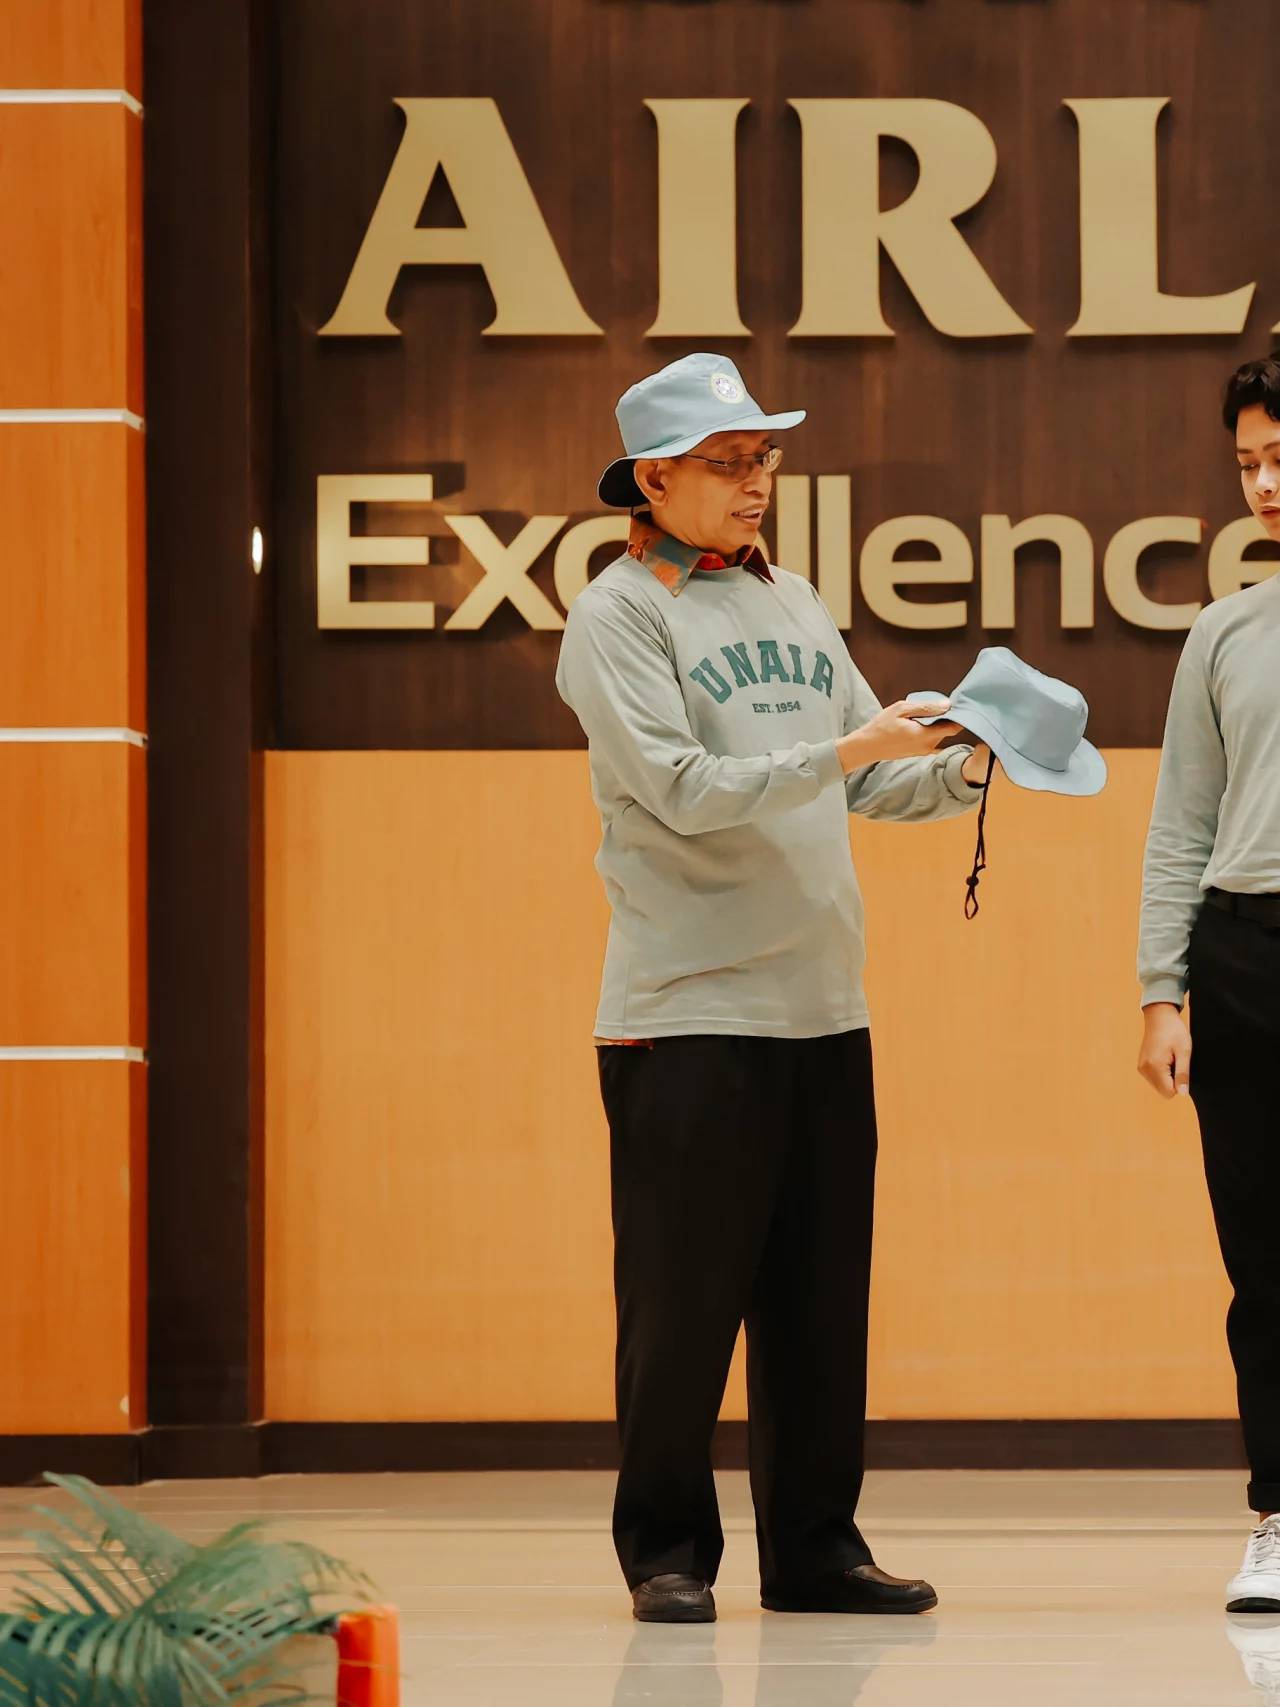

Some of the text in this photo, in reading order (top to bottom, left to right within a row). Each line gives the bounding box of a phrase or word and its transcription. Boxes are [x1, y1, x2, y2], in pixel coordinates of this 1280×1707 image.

[688, 640, 834, 704] UNAIR
[752, 700, 802, 714] EST. 1954
